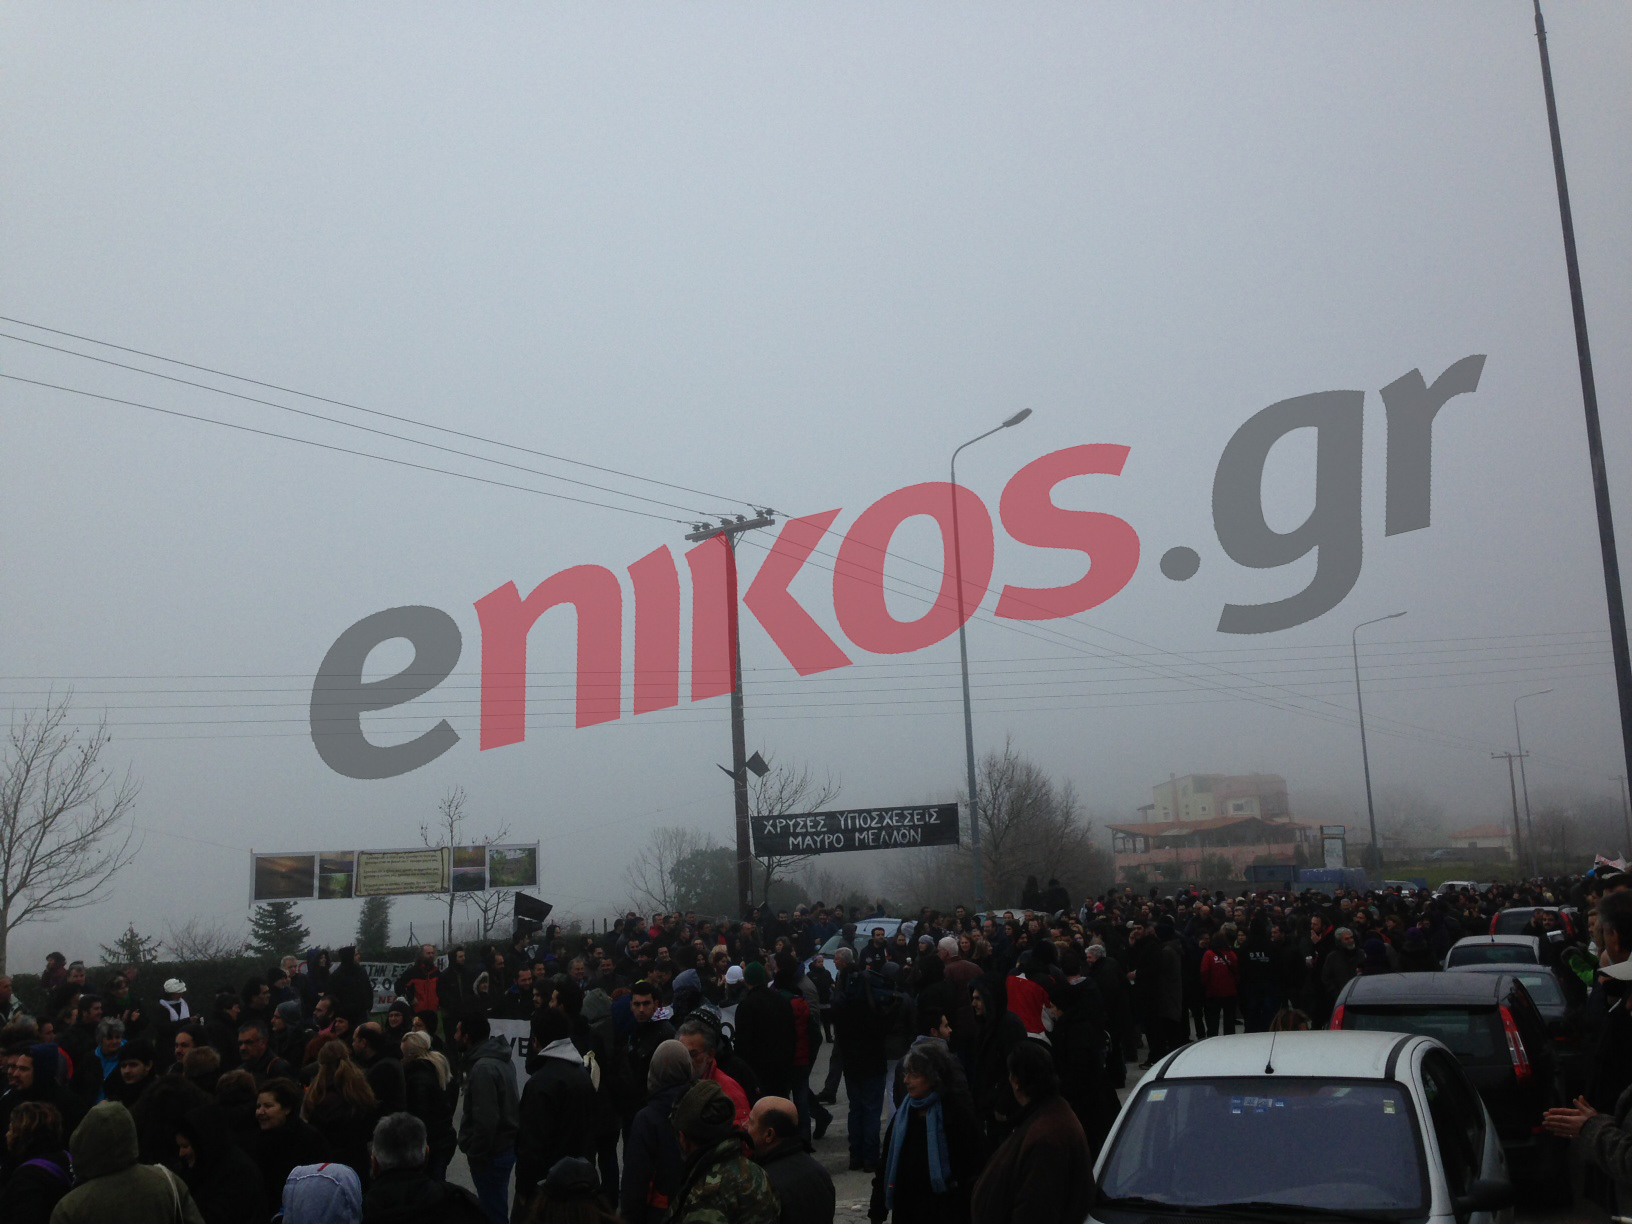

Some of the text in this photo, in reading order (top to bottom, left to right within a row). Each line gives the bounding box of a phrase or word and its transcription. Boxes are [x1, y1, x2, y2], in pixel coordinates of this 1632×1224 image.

[763, 806, 941, 835] ΧΡΥΣΕΣ ΥΠΟΣΧΕΣΕΙΣ
[788, 827, 922, 850] ΜΑΥΡΟ ΜΕΛΛΟΝ
